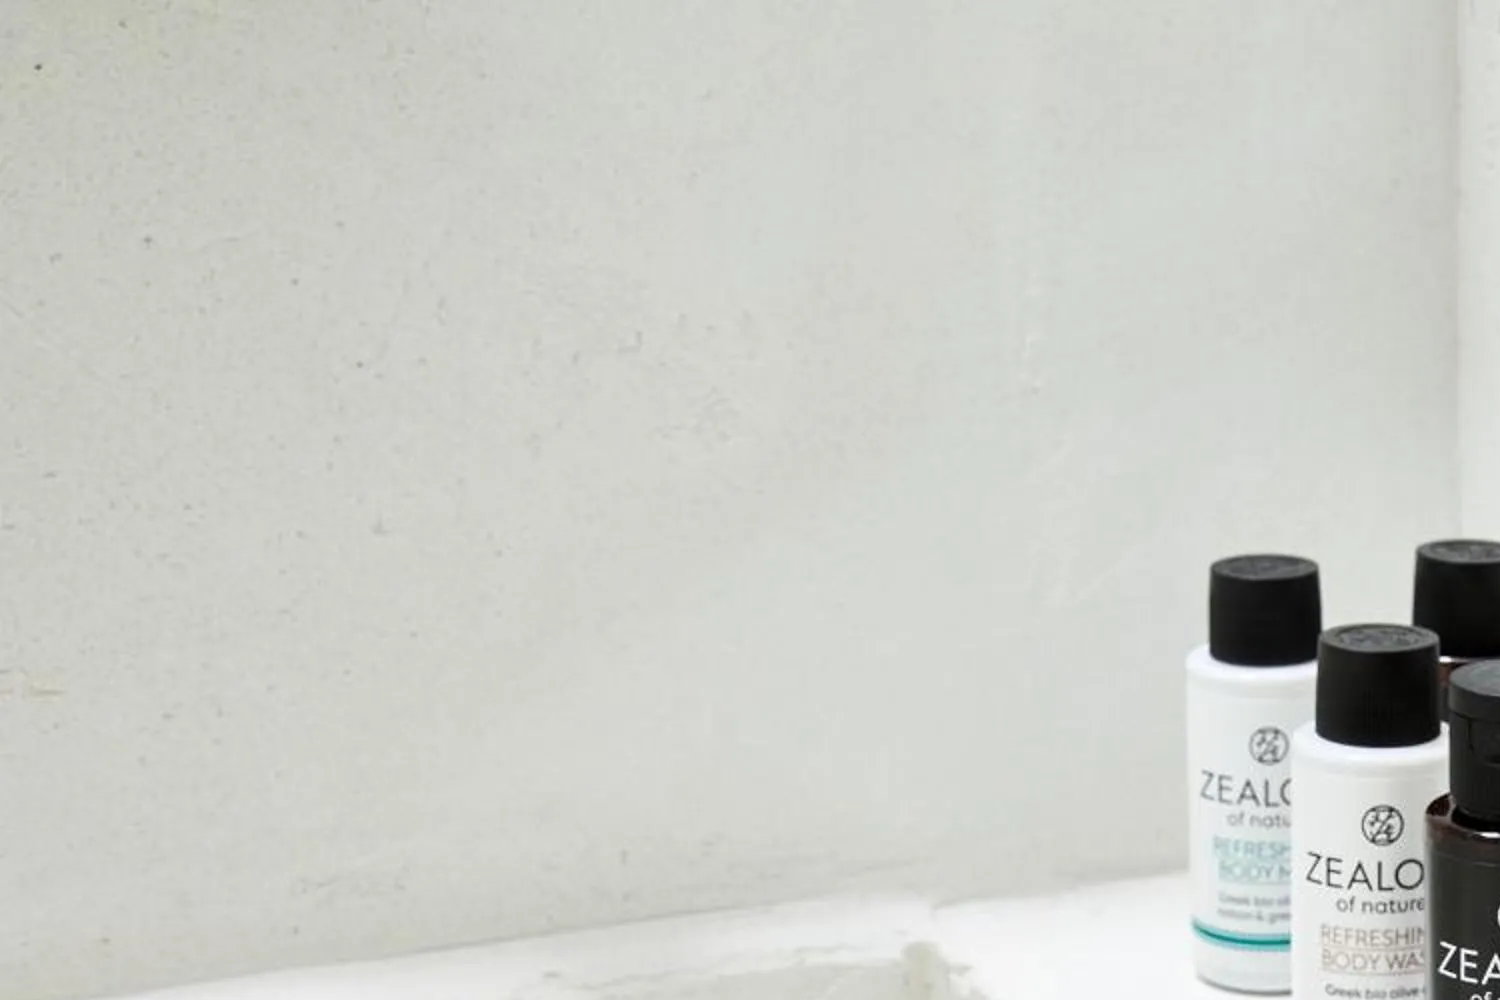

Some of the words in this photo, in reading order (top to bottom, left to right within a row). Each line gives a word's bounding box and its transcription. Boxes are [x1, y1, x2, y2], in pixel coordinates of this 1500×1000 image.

[1226, 811, 1245, 827] of
[1305, 850, 1425, 892] ZEALO
[1335, 895, 1356, 913] of
[1321, 948, 1378, 971] BODY
